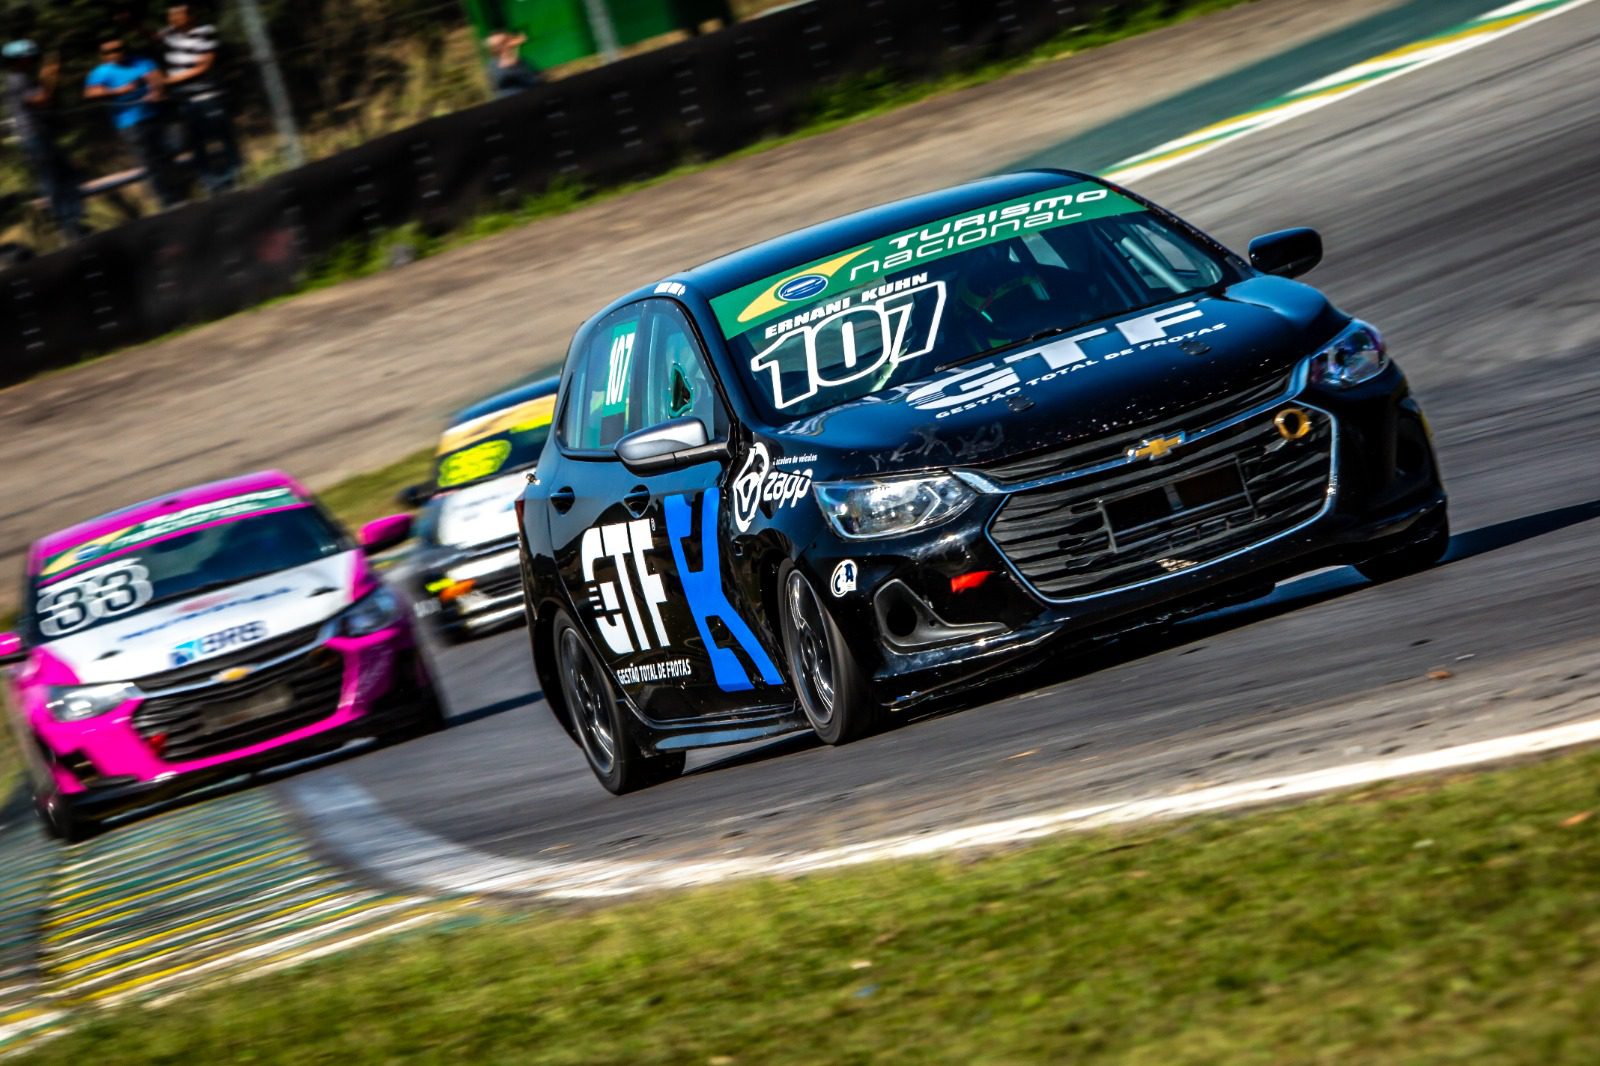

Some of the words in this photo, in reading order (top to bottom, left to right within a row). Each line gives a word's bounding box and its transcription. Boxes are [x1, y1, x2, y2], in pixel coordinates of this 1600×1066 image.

[765, 297, 851, 340] ERNANI
[861, 272, 929, 303] KUHN
[605, 332, 636, 406] 107
[750, 280, 947, 410] 107
[906, 301, 1204, 410] GTF
[935, 385, 1022, 419] GESTÃO
[1026, 359, 1099, 387] TOTAL
[1103, 345, 1134, 361] DE
[1140, 322, 1228, 351] FROTAS
[763, 468, 814, 509] zapp
[36, 563, 155, 637] 33
[616, 662, 640, 685] GESTÃO
[639, 663, 659, 682] TOTAL
[657, 662, 667, 680] DE
[666, 658, 692, 678] FROTAS
